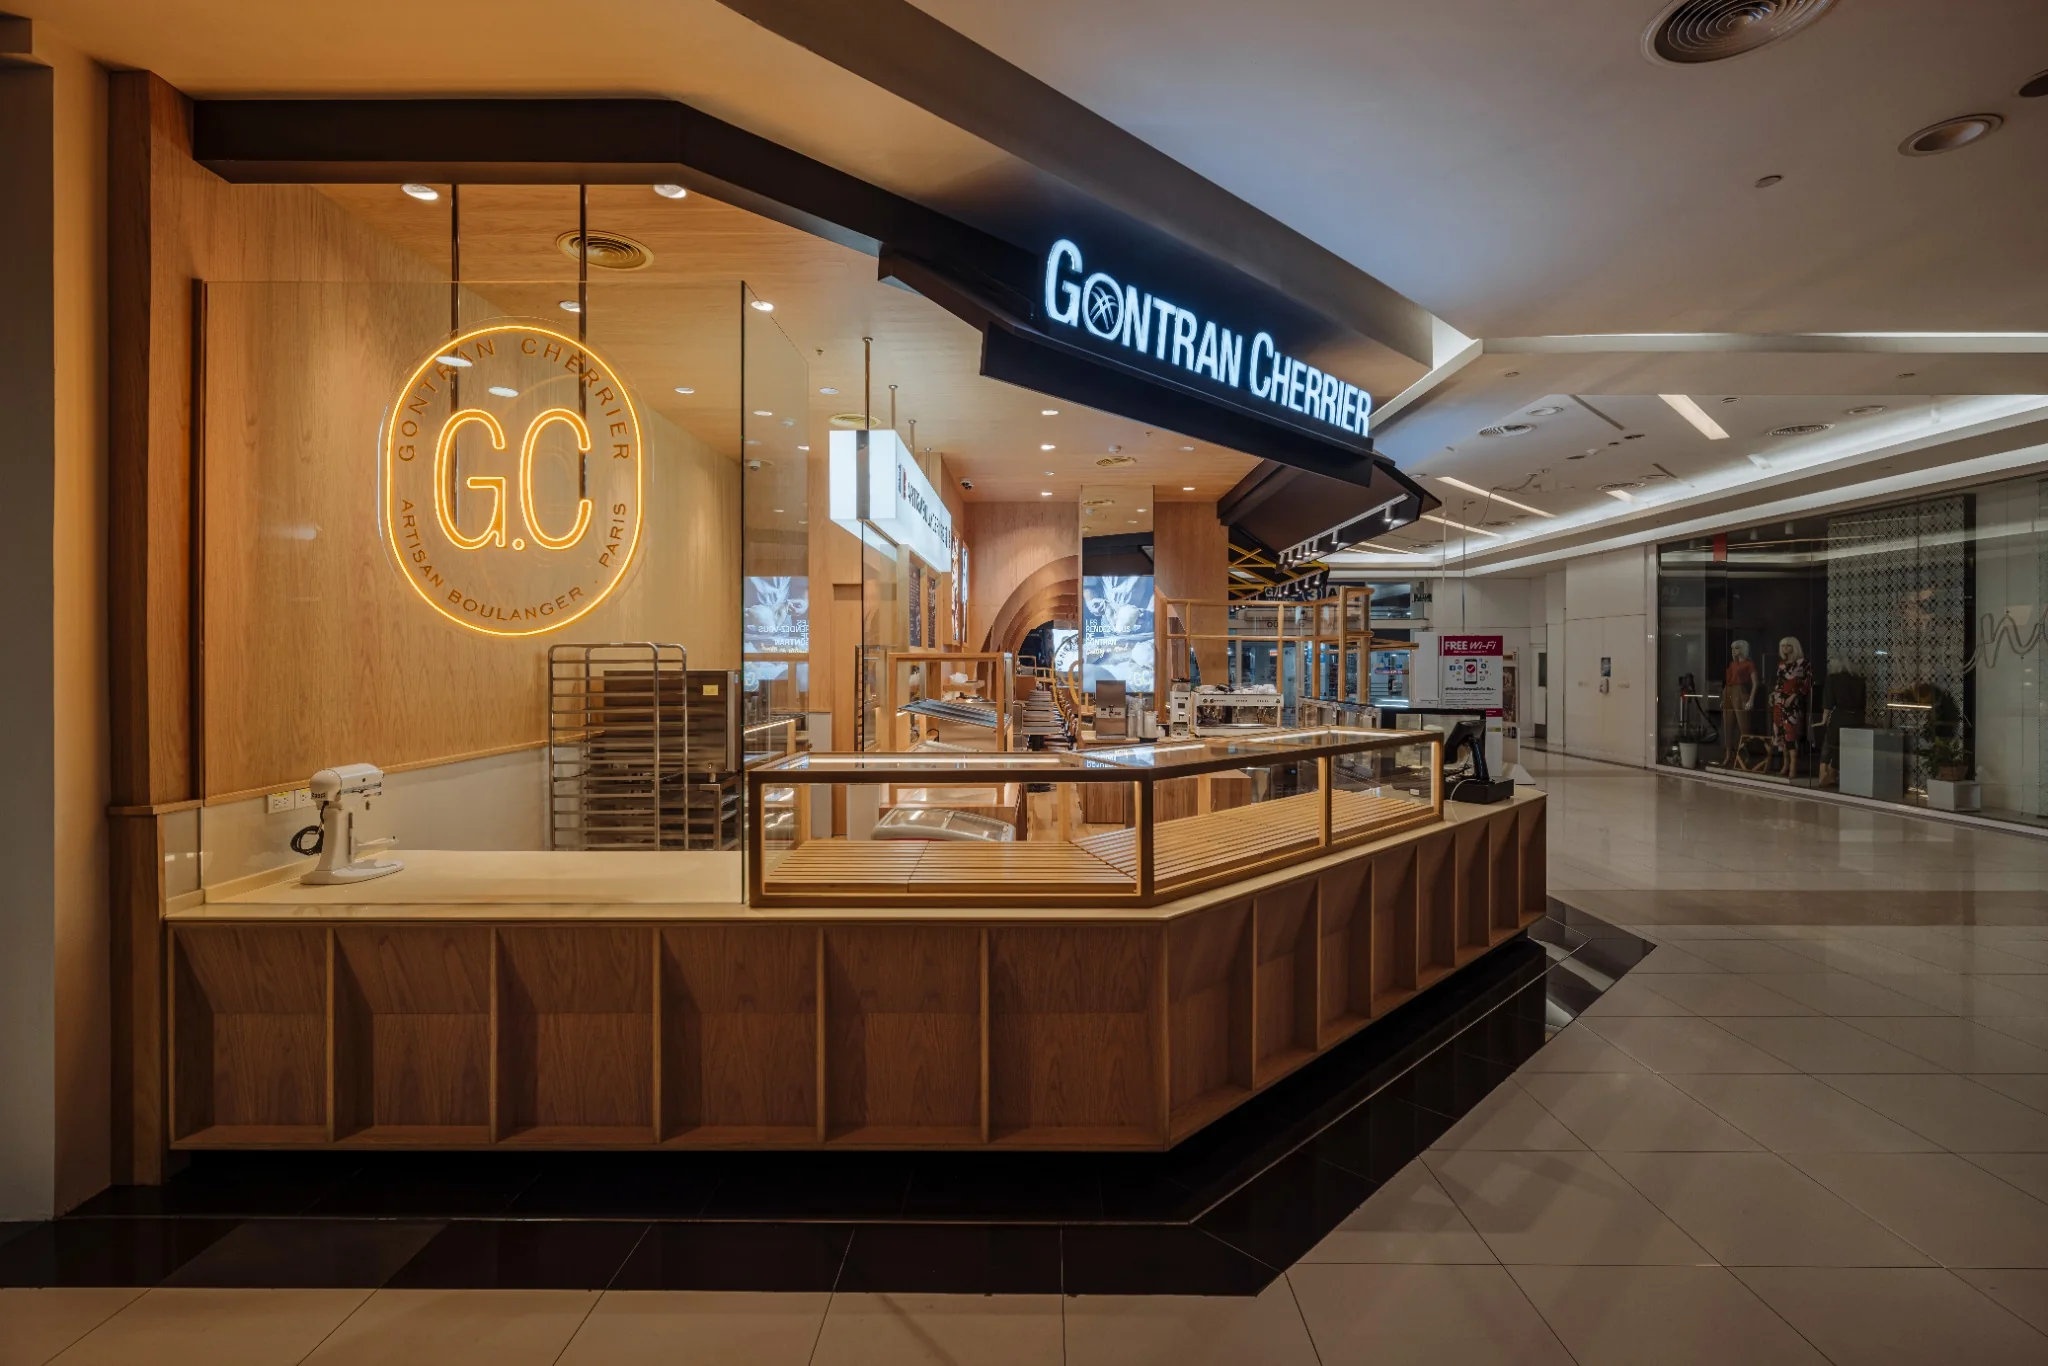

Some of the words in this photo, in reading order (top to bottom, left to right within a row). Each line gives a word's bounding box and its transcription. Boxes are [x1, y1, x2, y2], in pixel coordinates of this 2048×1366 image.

[521, 337, 630, 460] CHERRIER
[1044, 238, 1243, 388] GONTRAN
[1249, 331, 1374, 437] CHERRIER
[401, 499, 444, 588] ARTISAN
[447, 585, 585, 622] BOULANGER
[598, 502, 627, 569] PARIS
[1444, 640, 1468, 651] FREE
[1469, 640, 1497, 650] Wi-Fi
